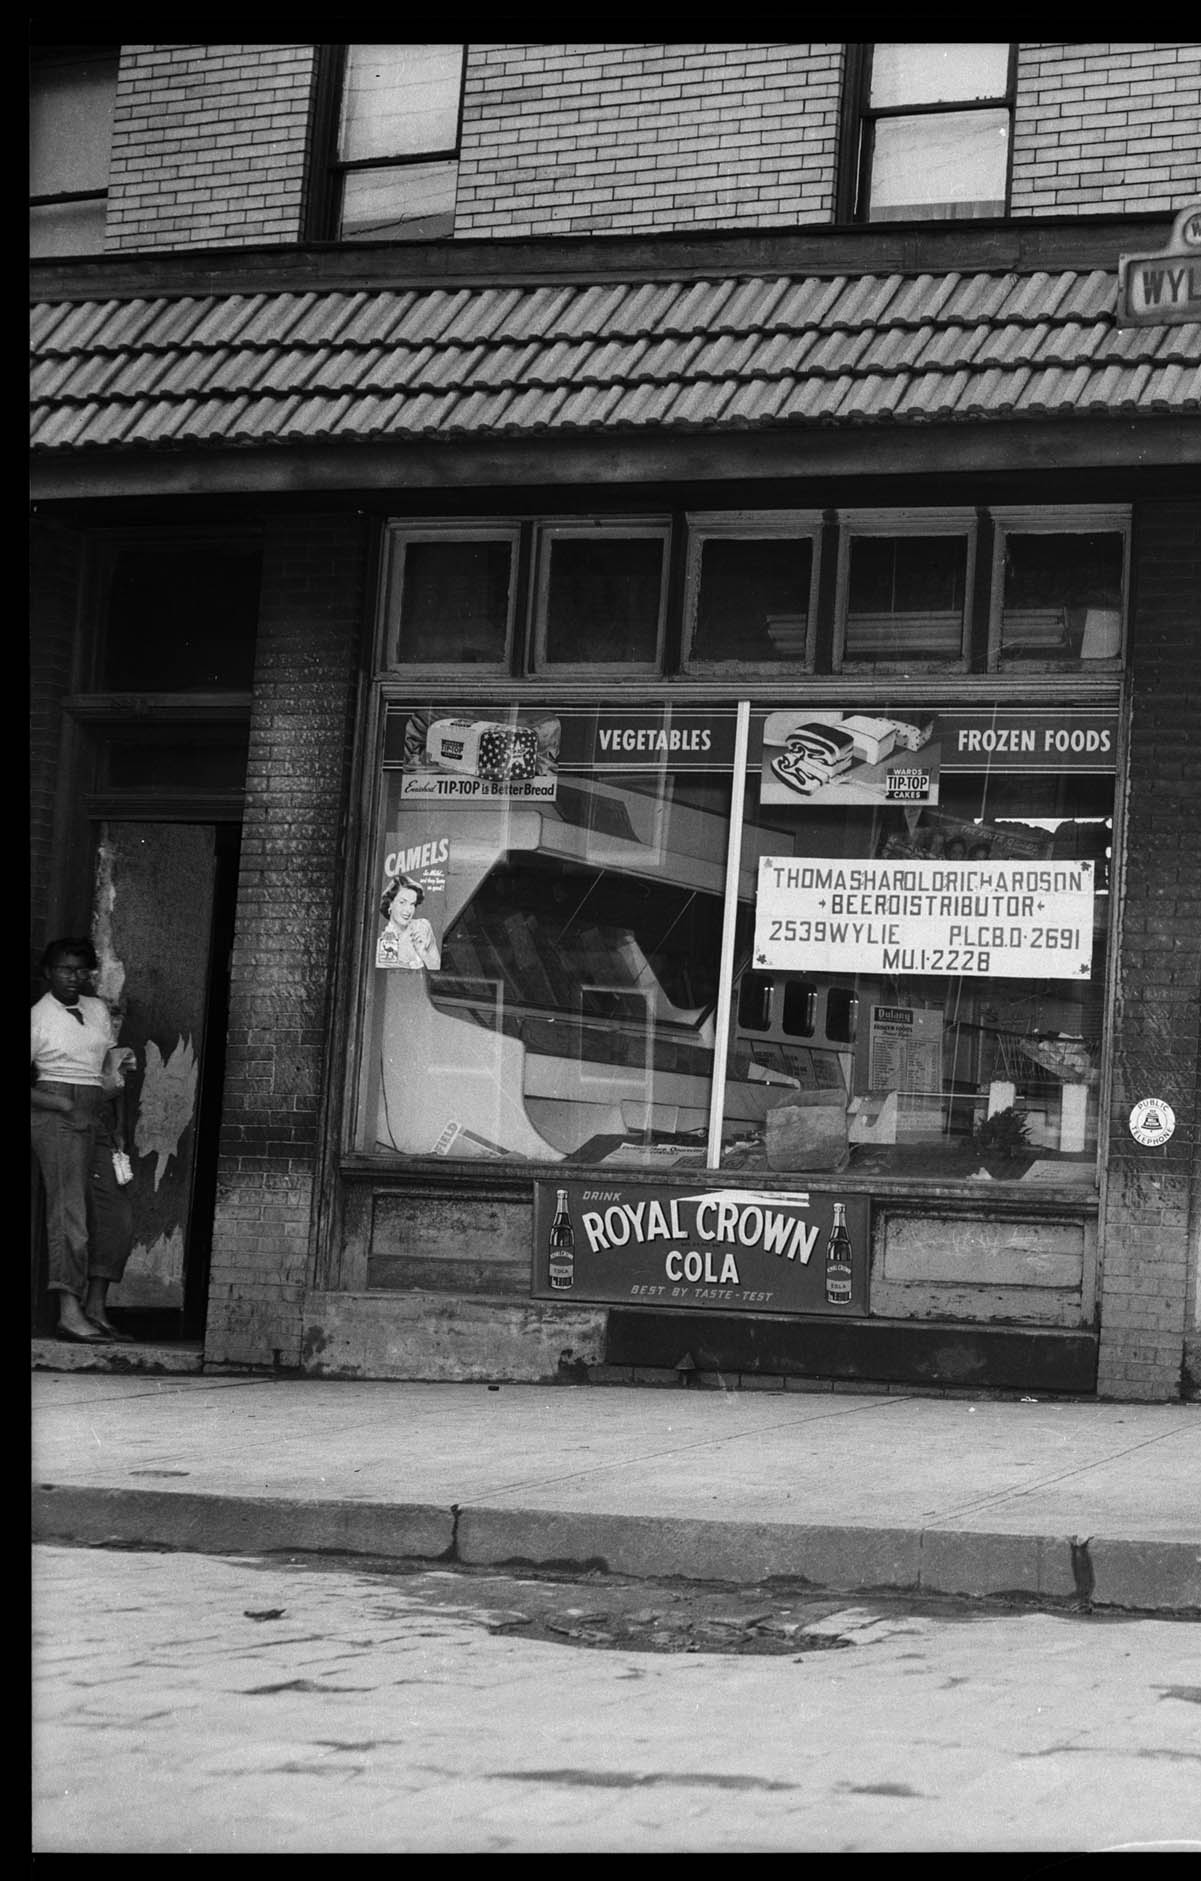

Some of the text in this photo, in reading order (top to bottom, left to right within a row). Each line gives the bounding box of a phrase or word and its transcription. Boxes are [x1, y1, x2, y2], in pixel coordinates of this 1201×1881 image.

[598, 728, 712, 751] VEGETABLES
[957, 729, 1111, 752] FROZEN FOODS
[437, 780, 480, 794] TIP-TOP
[481, 783, 490, 795] is
[491, 782, 524, 795] Better
[524, 783, 555, 796] Bread
[888, 776, 928, 789] TIP-TOP
[893, 791, 921, 799] CAKES
[384, 837, 450, 878] CAMELS
[1137, 1099, 1169, 1112] PUBLIC
[1131, 1126, 1173, 1145] TELEPHONE
[582, 1190, 622, 1202] DRINK
[582, 1199, 820, 1265] ROYAL CROWN
[665, 1250, 740, 1285] COLA
[631, 1285, 668, 1297] BEST
[672, 1287, 689, 1298] BY
